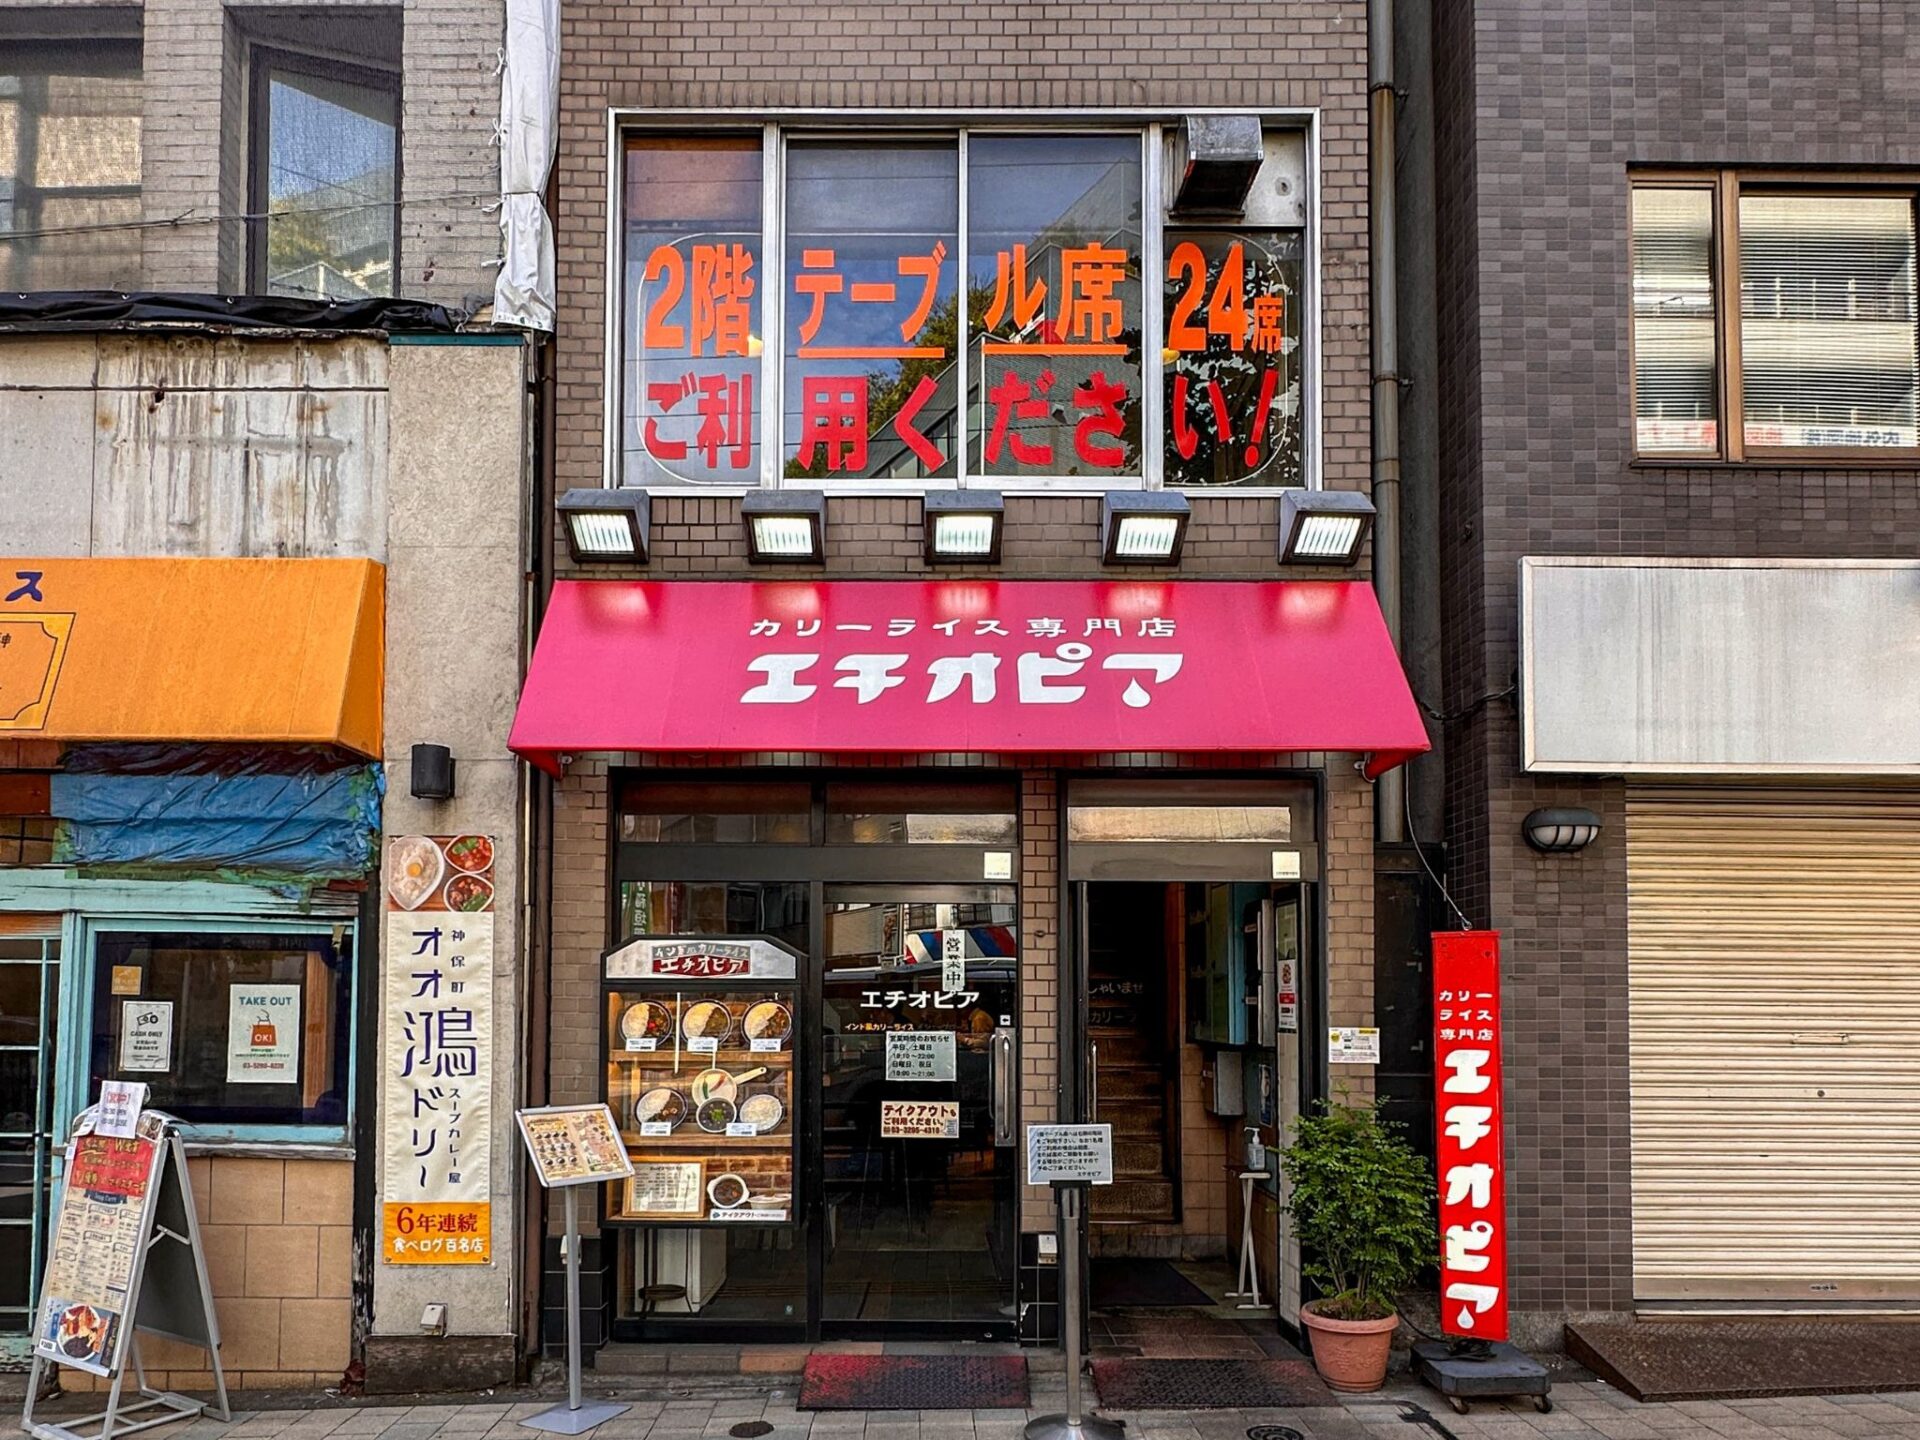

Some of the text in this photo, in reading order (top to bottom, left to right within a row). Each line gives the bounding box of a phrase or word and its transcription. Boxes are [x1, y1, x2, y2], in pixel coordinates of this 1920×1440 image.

[5, 571, 43, 602] ス
[748, 617, 1177, 638] カリーライス専門店
[740, 642, 1184, 708] エチオピア
[450, 929, 466, 994] 神保町
[659, 955, 745, 975] エチオピア
[945, 937, 964, 986] 営業中
[239, 997, 292, 1006] TAKE OUT
[860, 989, 981, 1010] エチオピア
[1439, 990, 1493, 1002] カリー
[1440, 1009, 1493, 1021] ライス
[254, 1034, 273, 1042] OK!
[889, 1035, 950, 1043] 営業時間のお知らせ
[1440, 1028, 1494, 1041] 専門店
[448, 1088, 463, 1184] スープカレー屋
[1443, 1049, 1500, 1330] エチオピア
[396, 1206, 478, 1235] 6年連続
[393, 1236, 484, 1254] 食べログ百名店
